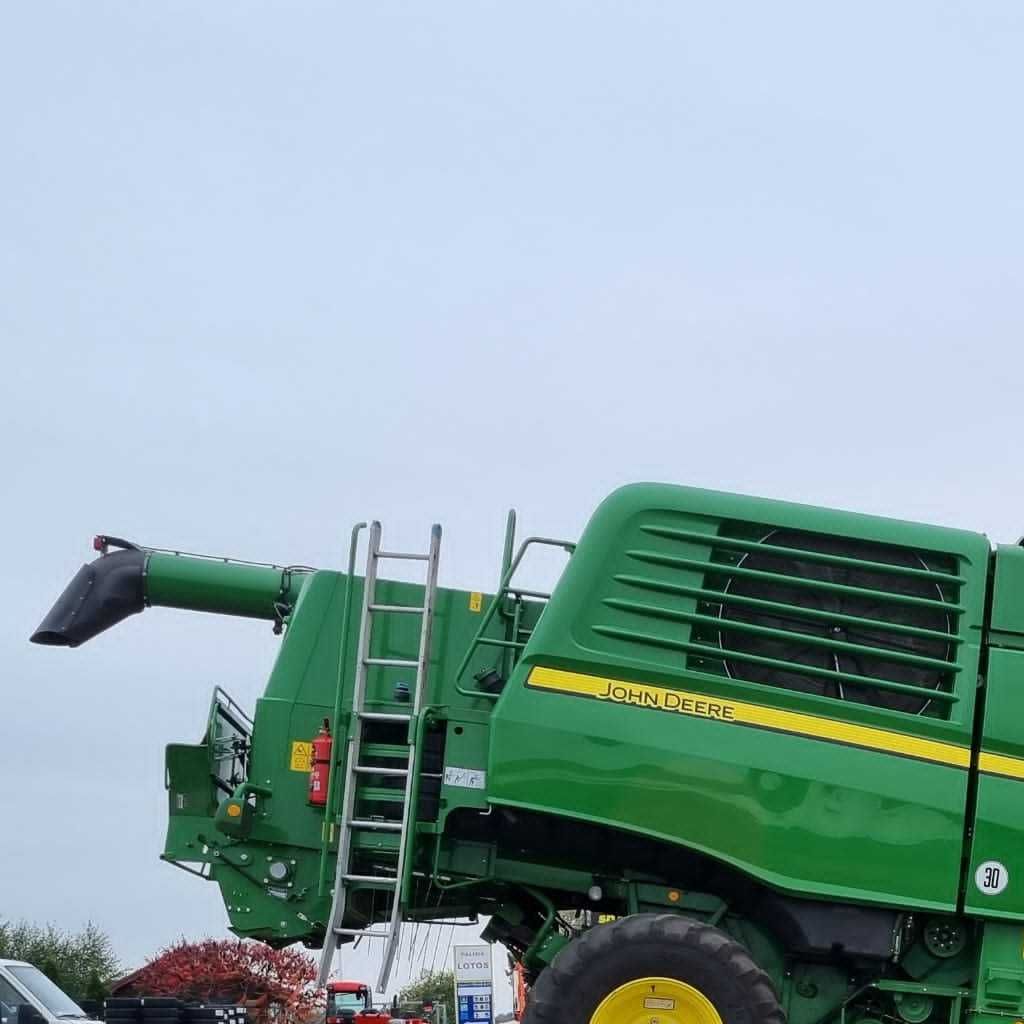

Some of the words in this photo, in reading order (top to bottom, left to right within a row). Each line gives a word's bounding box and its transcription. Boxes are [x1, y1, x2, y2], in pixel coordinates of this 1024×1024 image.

[599, 682, 659, 706] JOHN
[664, 692, 736, 720] DEERE
[983, 867, 1000, 889] 30
[457, 961, 489, 970] LOTOS
